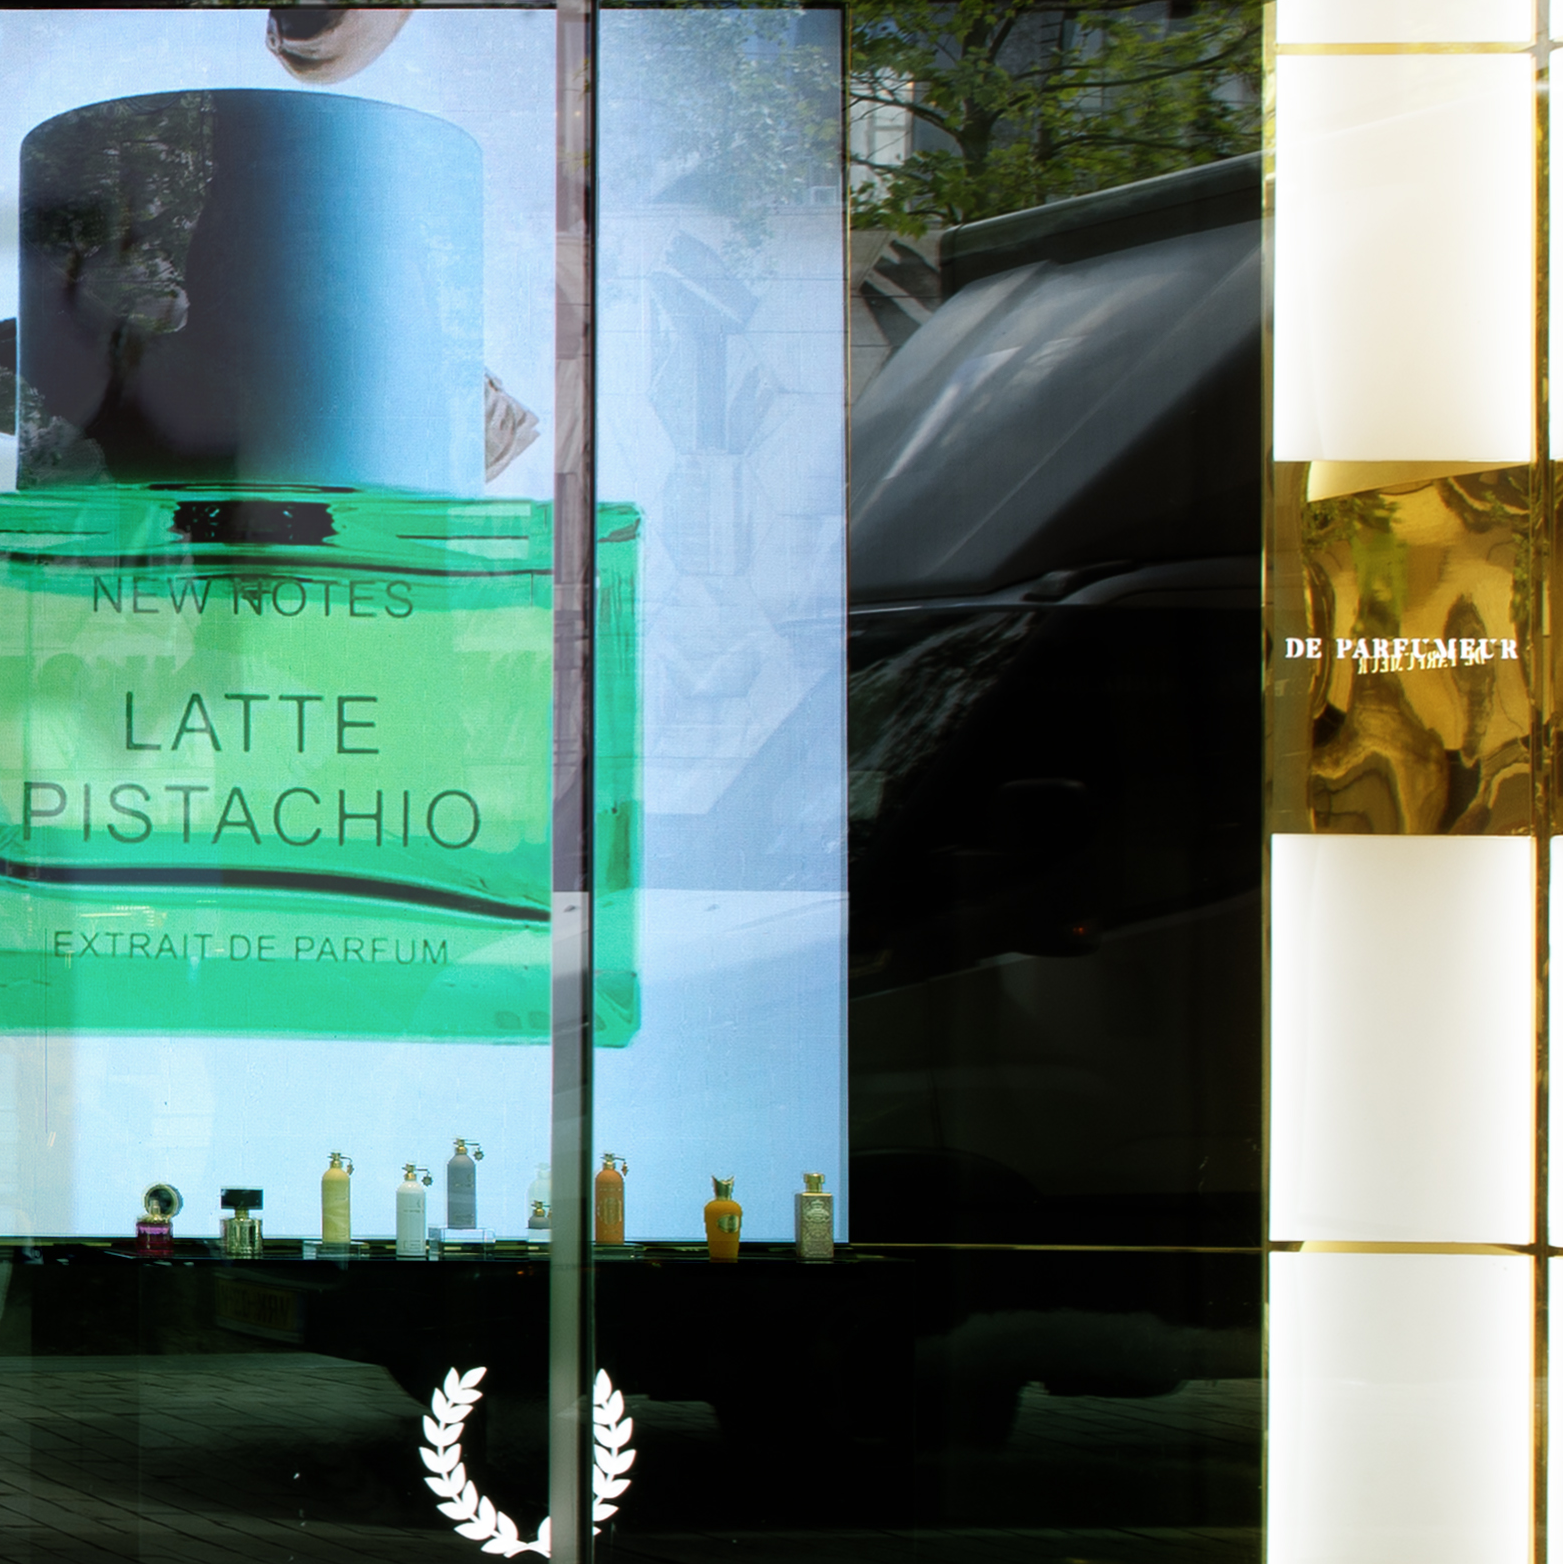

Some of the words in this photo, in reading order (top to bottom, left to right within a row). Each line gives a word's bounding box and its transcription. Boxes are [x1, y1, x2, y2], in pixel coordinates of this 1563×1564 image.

[93, 575, 211, 614] NEW
[233, 577, 415, 619] NOTES
[1285, 637, 1322, 658] DE
[1336, 637, 1518, 659] PARFUMEUR
[124, 691, 380, 754] LATTE
[21, 781, 482, 850] PISTACHIO
[52, 930, 213, 961] EXTRAIT
[228, 934, 276, 962] DE
[294, 936, 450, 965] PARFUM
